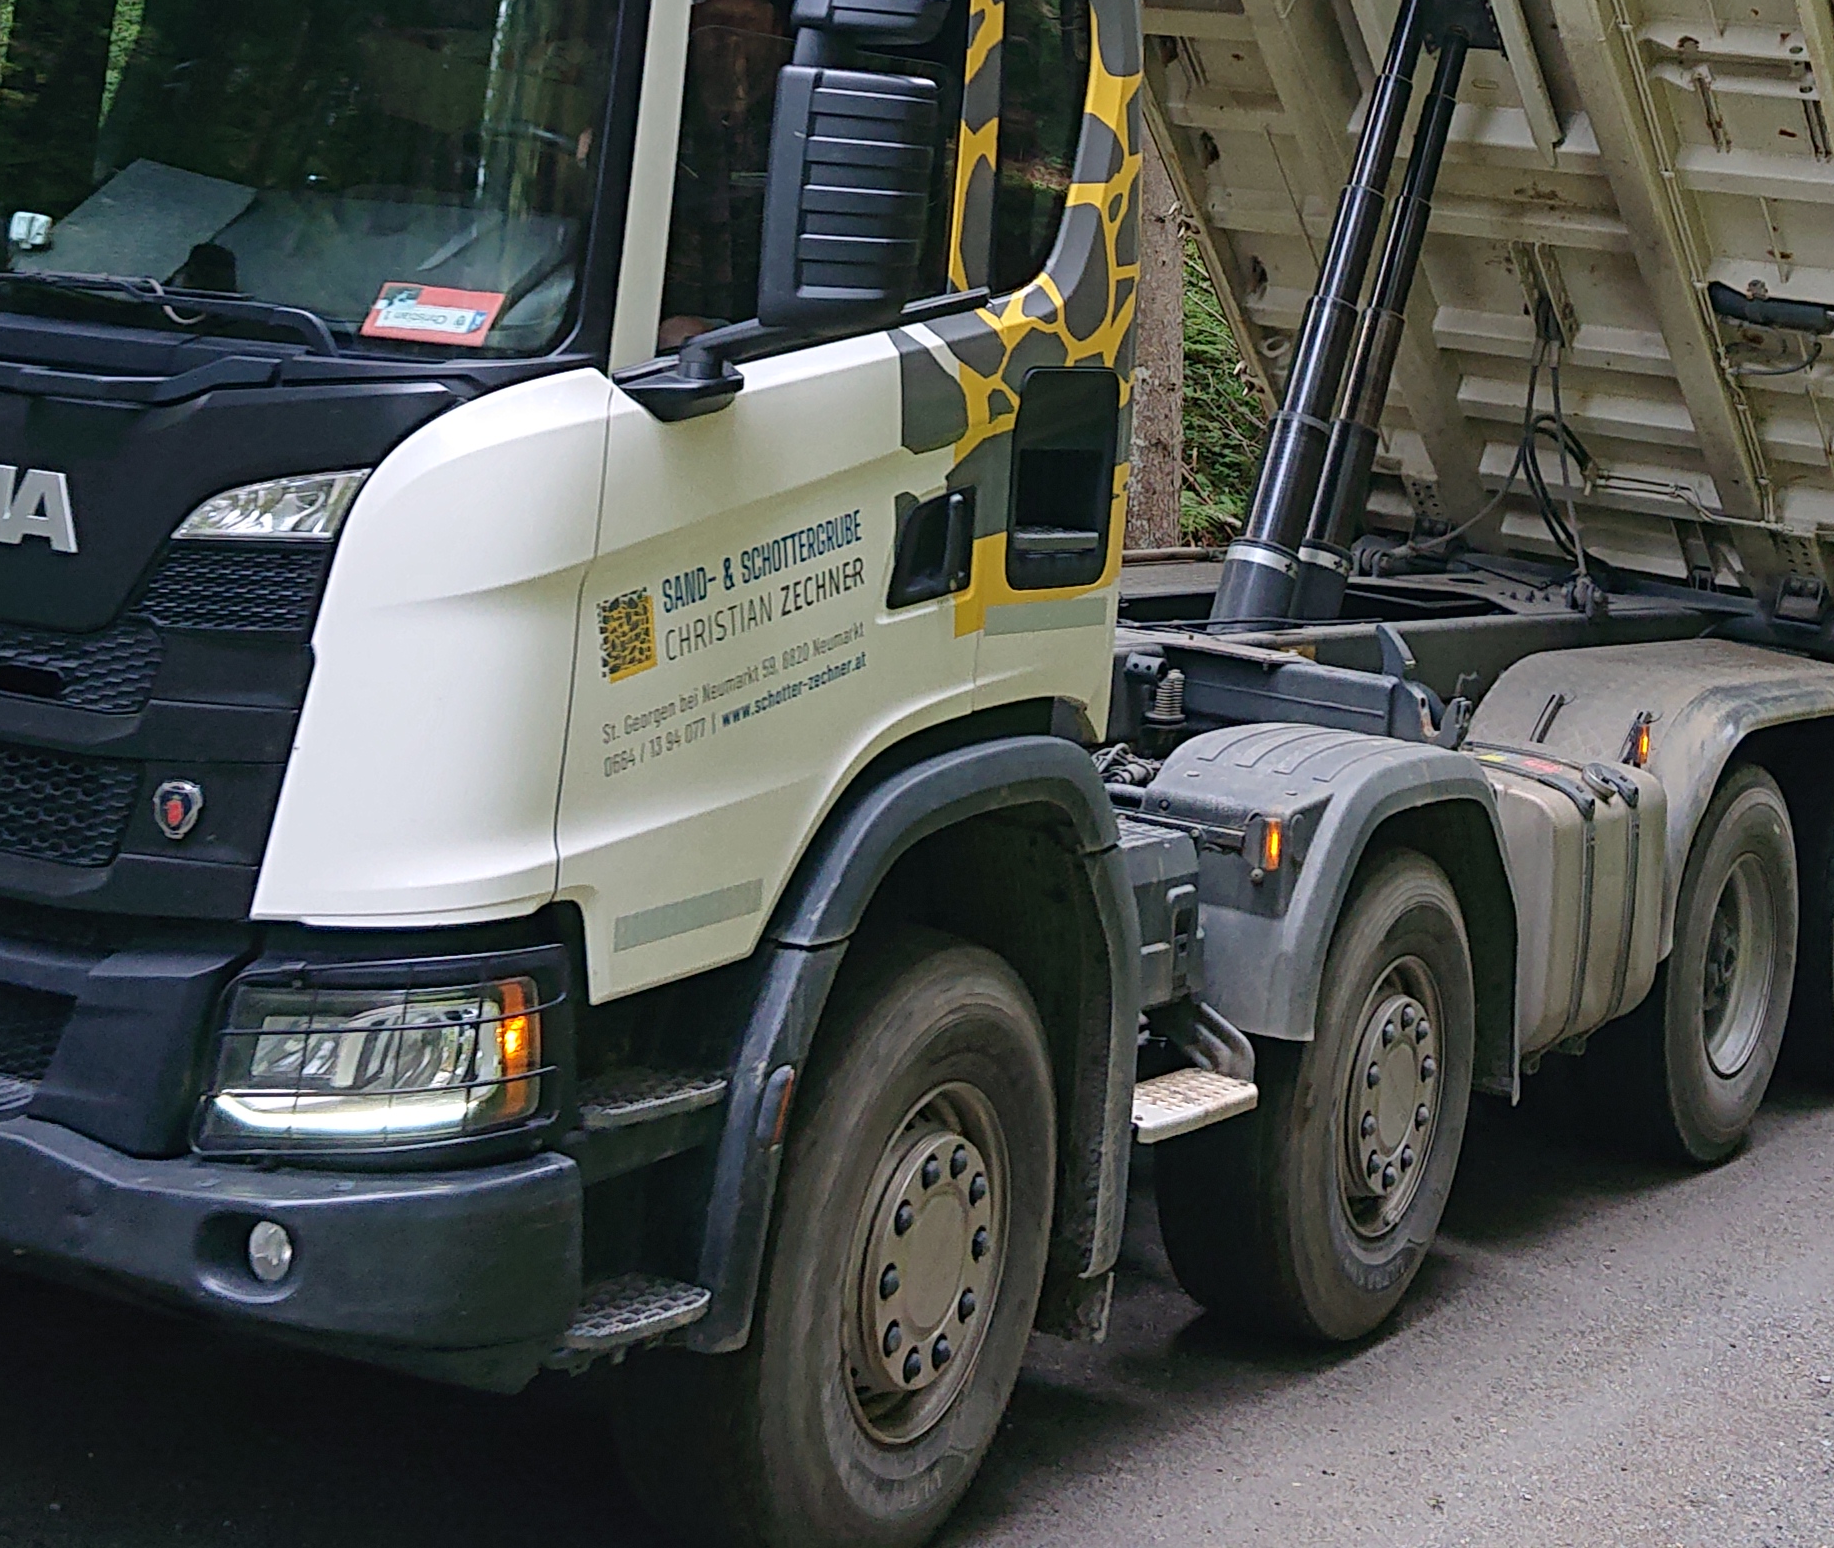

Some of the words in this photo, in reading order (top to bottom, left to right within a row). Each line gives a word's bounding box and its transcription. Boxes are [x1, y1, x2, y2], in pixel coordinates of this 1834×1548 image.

[661, 566, 717, 613] SAND-
[723, 556, 736, 591] &
[741, 509, 863, 584] SCHOTTERGRUBE
[664, 591, 773, 661] CHRISTIAN
[780, 556, 865, 617] ZECHNER
[602, 723, 621, 744] St.
[624, 702, 676, 734] Georgen
[679, 687, 699, 713] bei
[702, 665, 760, 703] Neumarkt
[812, 621, 865, 657] Neumarkt
[685, 717, 706, 744] 077
[721, 651, 867, 728] www.schotter-zechner.at
